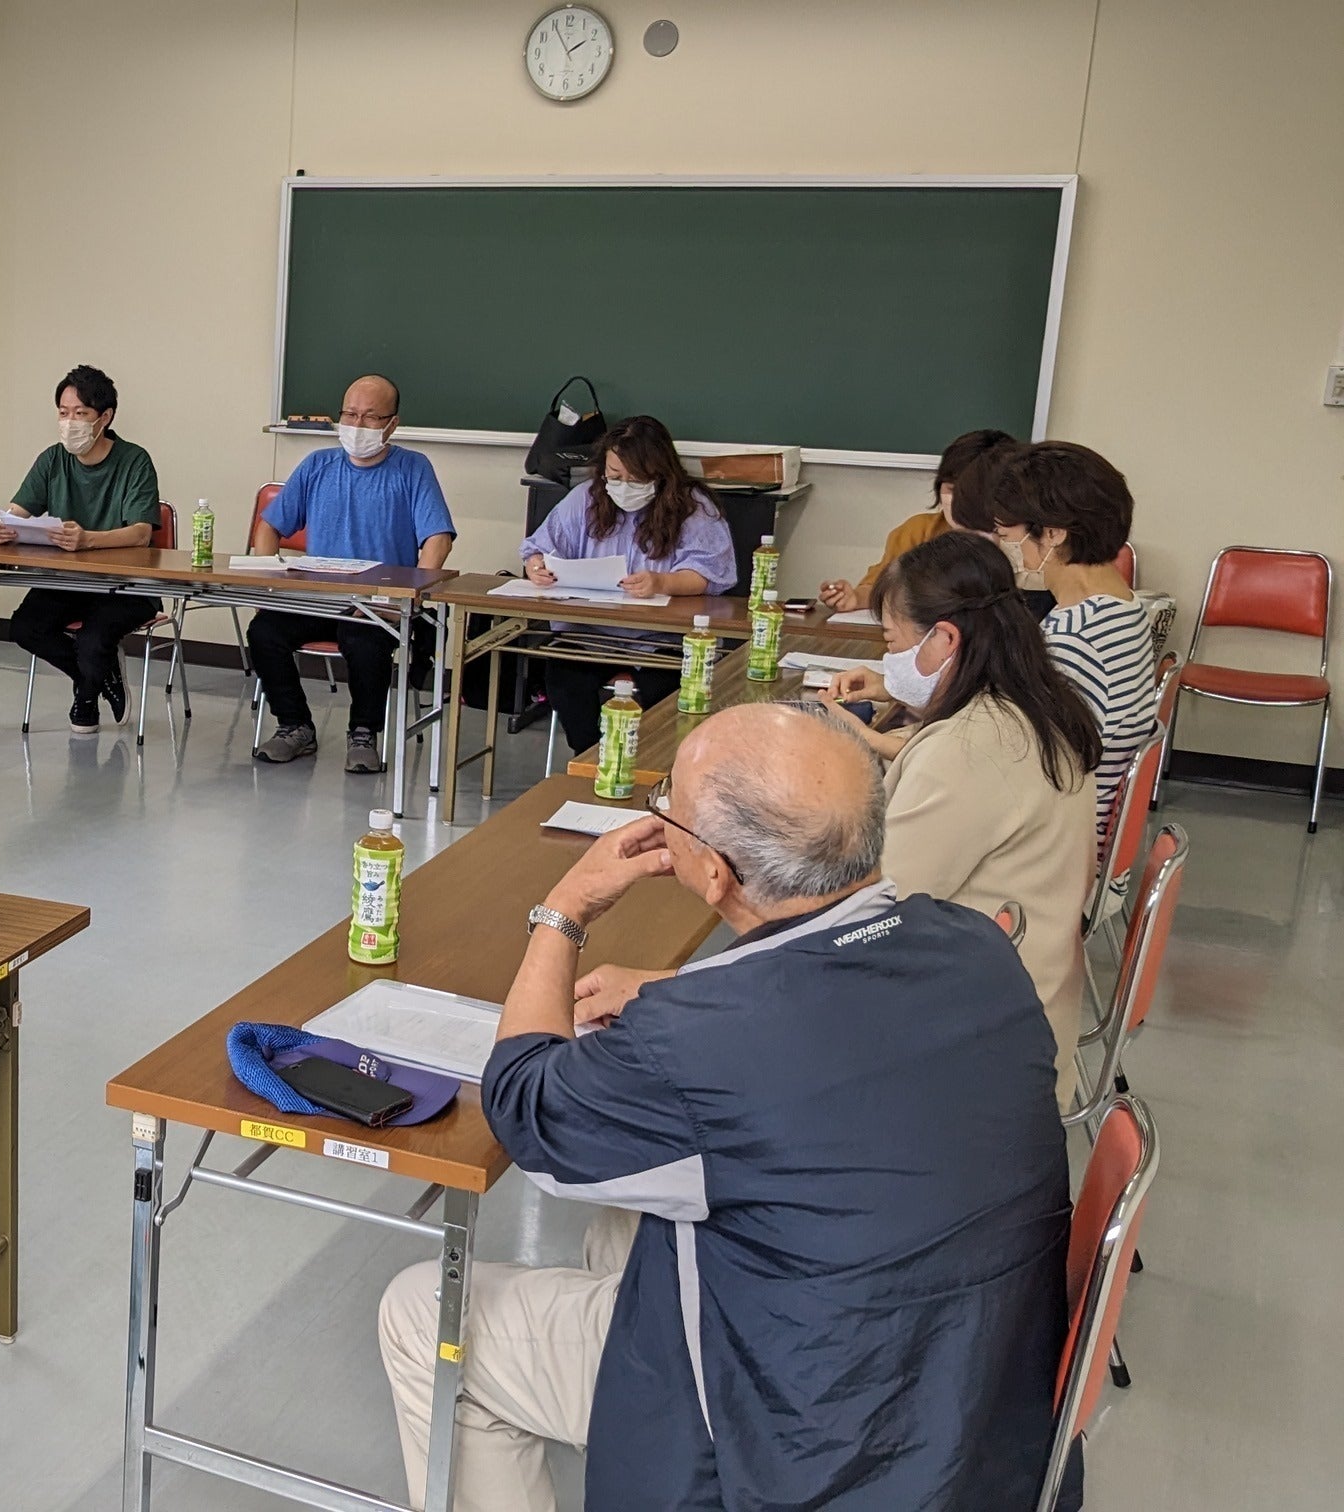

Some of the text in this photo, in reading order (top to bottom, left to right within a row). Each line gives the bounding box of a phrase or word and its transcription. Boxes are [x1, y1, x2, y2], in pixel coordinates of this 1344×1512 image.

[566, 15, 574, 27] 12
[583, 19, 585, 30] 1
[540, 32, 547, 43] 10
[591, 29, 597, 41] 2
[534, 48, 541, 60] 9
[596, 46, 601, 57] 3
[539, 64, 544, 75] 8
[589, 63, 594, 74] 4
[548, 75, 554, 87] 7
[563, 79, 568, 91] 6
[578, 74, 583, 86] 5
[362, 861, 388, 870] 香り立つ
[362, 893, 375, 923] 綾鷹
[863, 930, 890, 944] SPORTS
[249, 1124, 294, 1143] 都賀CC
[333, 1143, 378, 1163] 講習室1
